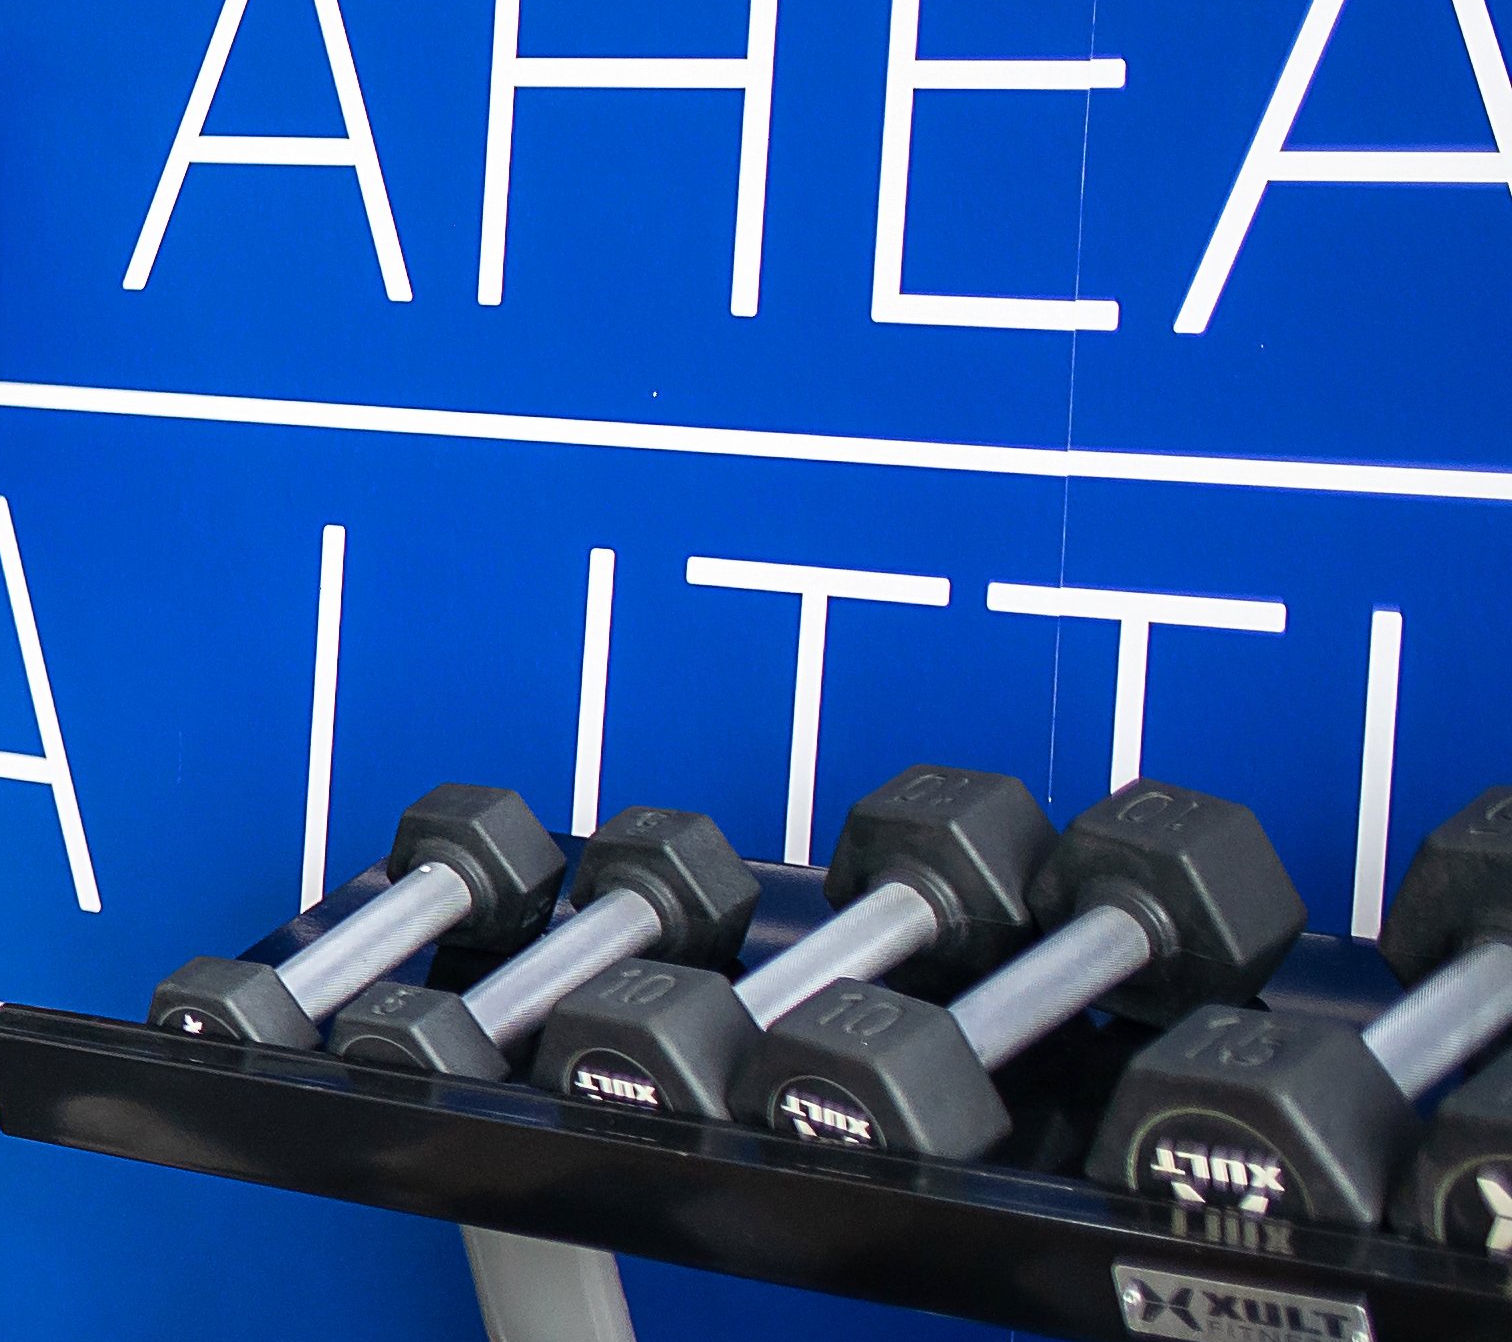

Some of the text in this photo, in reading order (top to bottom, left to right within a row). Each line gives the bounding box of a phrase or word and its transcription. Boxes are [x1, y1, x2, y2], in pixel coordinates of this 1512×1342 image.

[598, 968, 676, 1006] 10
[817, 993, 905, 1036] 10
[1184, 1015, 1280, 1066] 15
[574, 1069, 658, 1106] XULT
[779, 1093, 871, 1139] XULT
[1150, 1146, 1286, 1192] XULT
[1201, 1289, 1350, 1339] XULT
